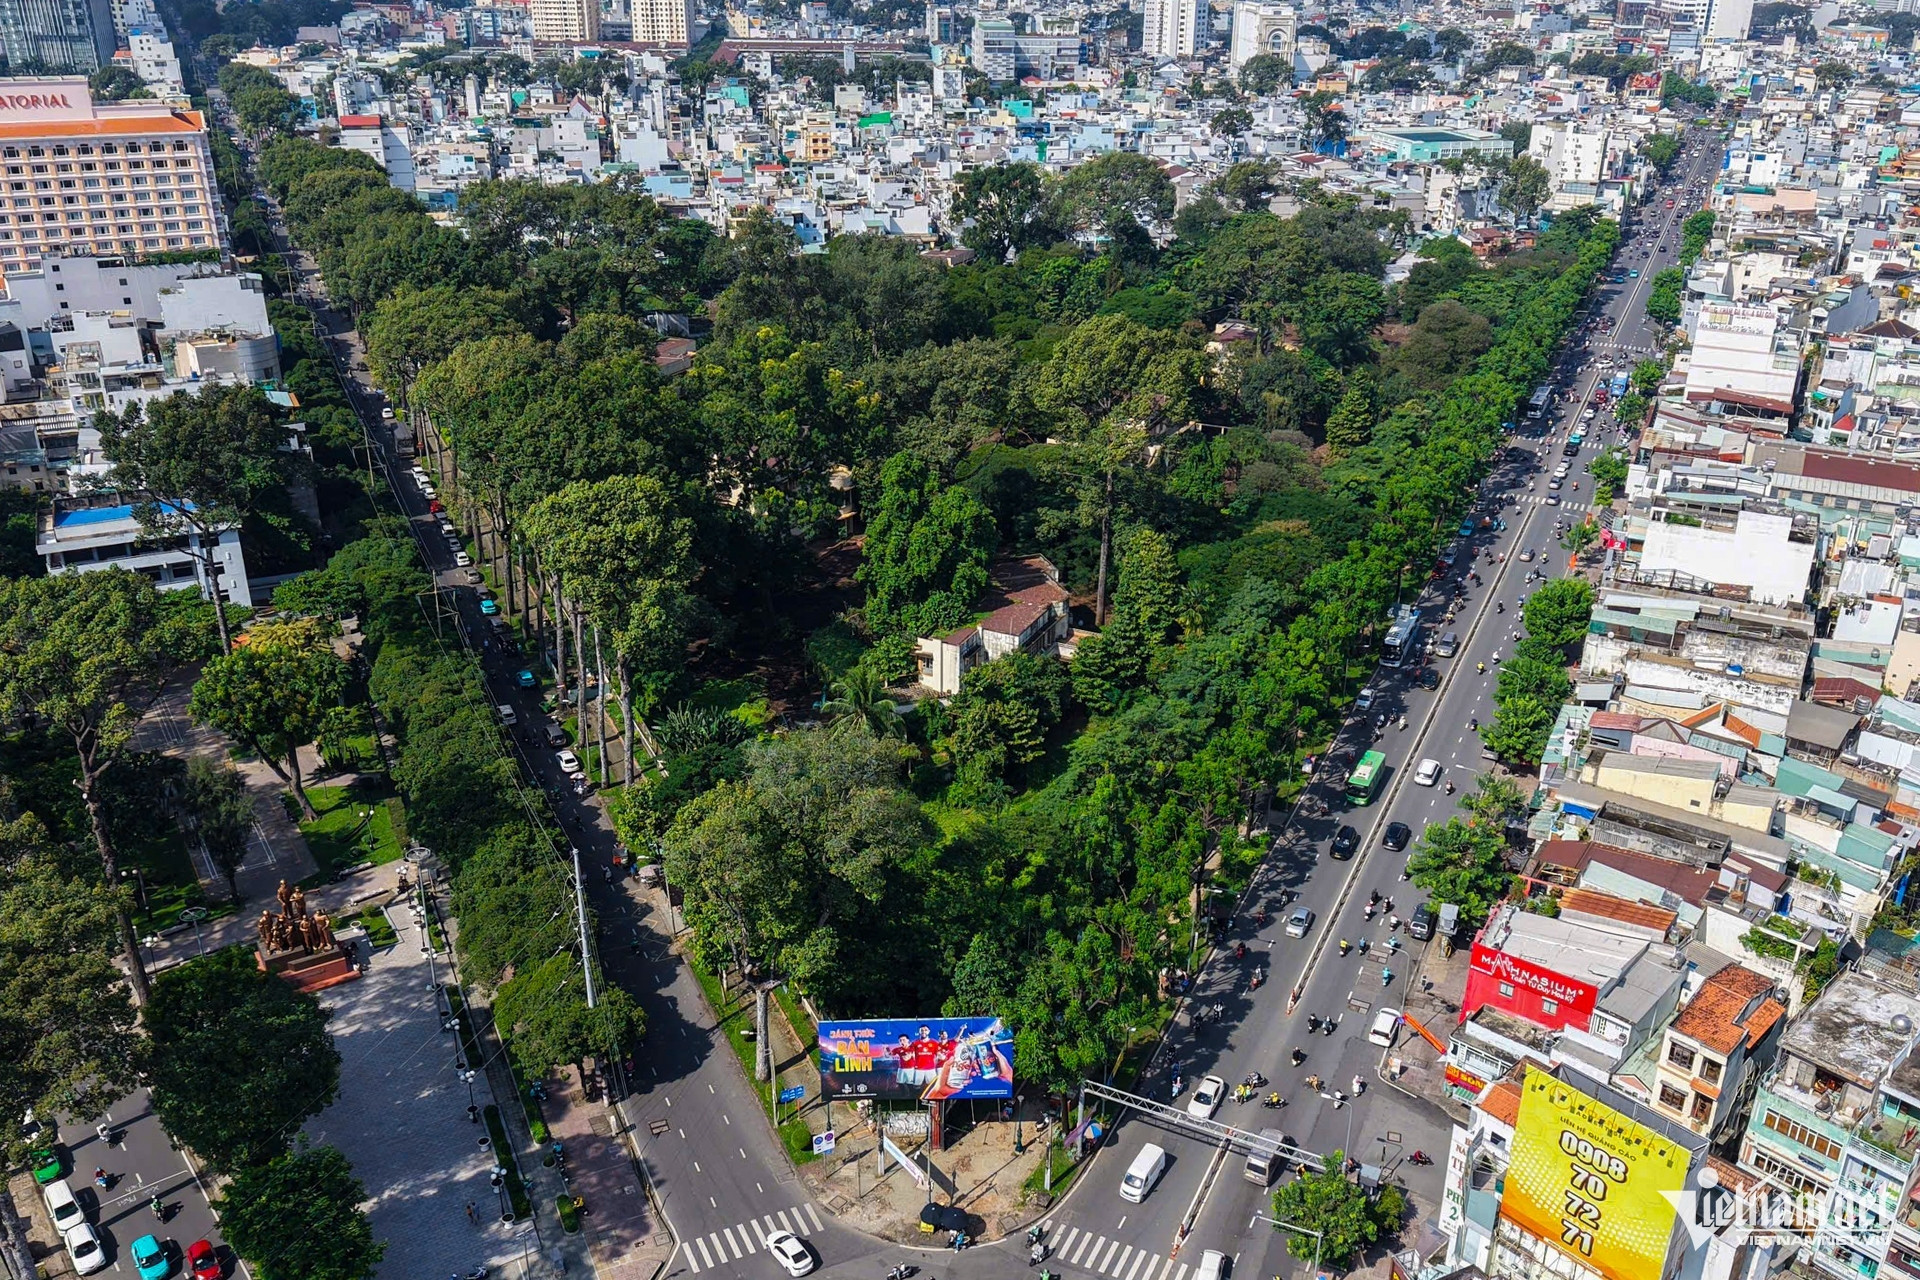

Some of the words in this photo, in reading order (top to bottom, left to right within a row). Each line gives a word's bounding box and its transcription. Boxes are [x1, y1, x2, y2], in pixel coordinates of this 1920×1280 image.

[1558, 1129, 1629, 1184] 0908
[1570, 1162, 1607, 1201] 70
[1564, 1189, 1602, 1231] 72
[1561, 1218, 1595, 1257] 71
